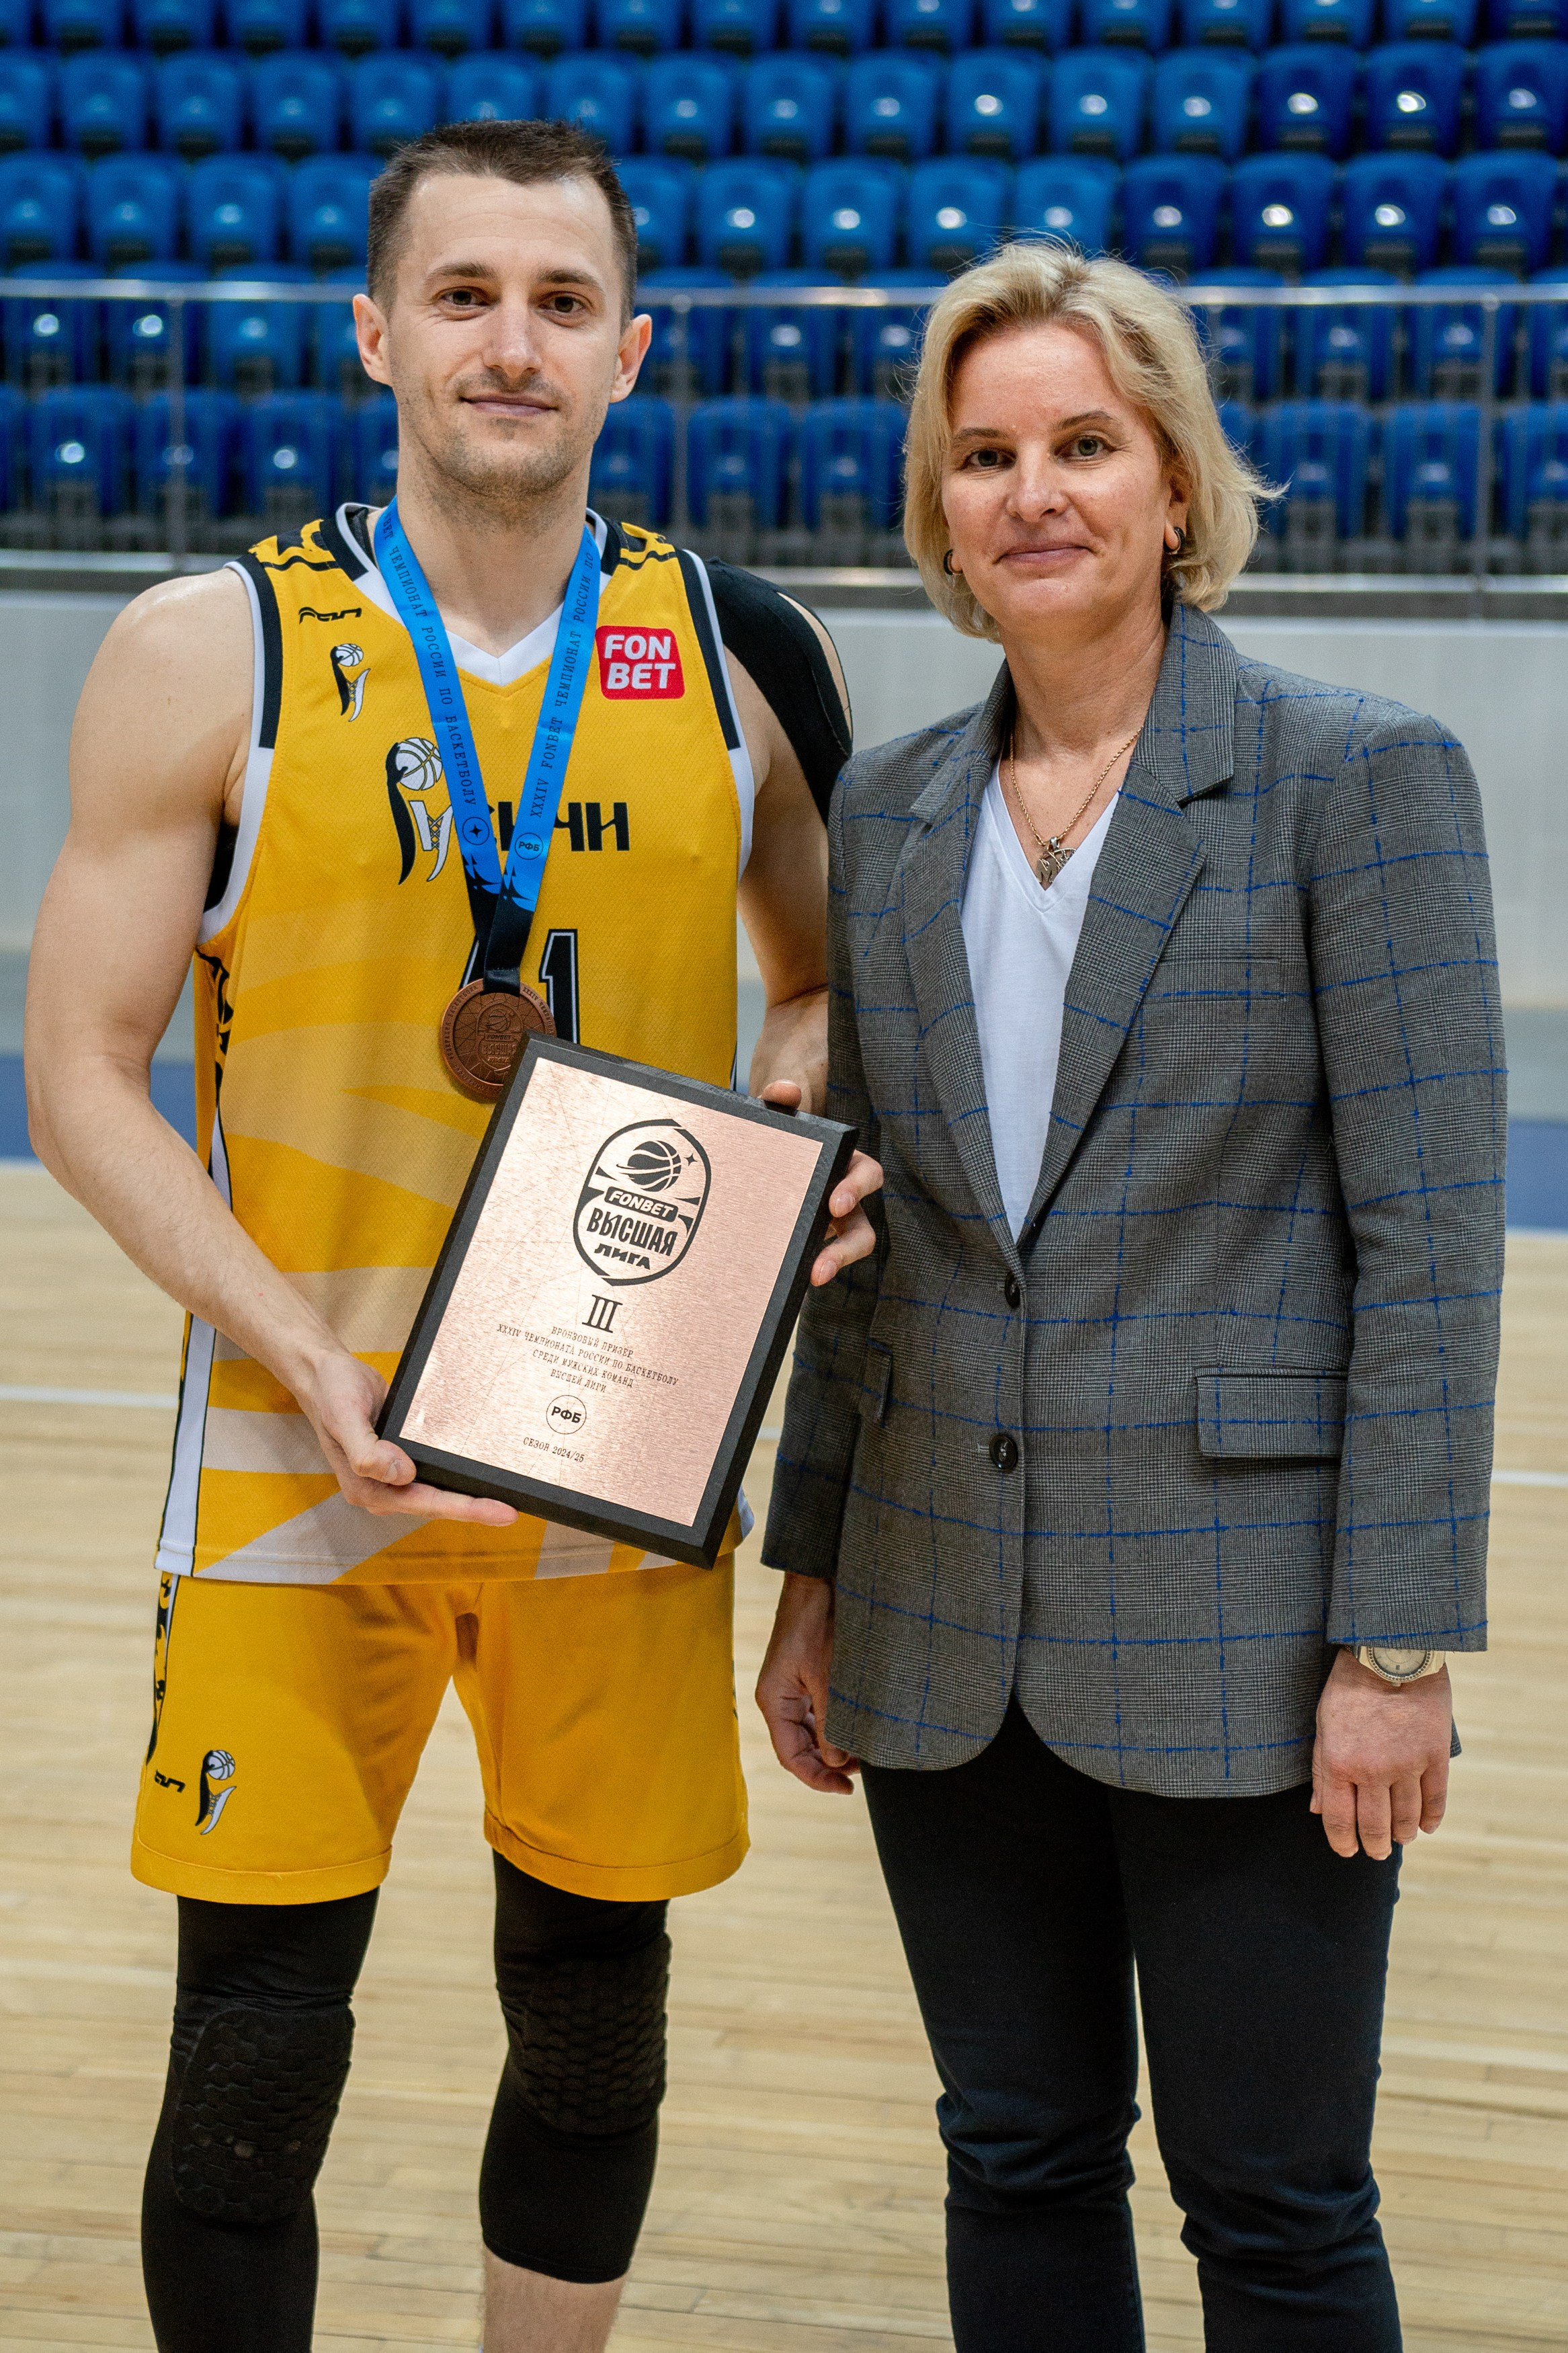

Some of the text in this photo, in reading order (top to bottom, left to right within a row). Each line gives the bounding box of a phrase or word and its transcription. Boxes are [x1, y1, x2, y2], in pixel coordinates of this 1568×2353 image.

[604, 635, 671, 660] FON
[389, 546, 428, 617] ЧЕМПИОНАТ
[421, 626, 447, 678] РОССИИ
[439, 688, 453, 705] ПО
[446, 715, 477, 805] БАСКЕТБОЛУ
[530, 777, 549, 818] XXXIV
[541, 717, 563, 769] FONBET
[555, 631, 581, 707] ЧЕМПИОНАТ
[573, 575, 591, 623] РОССИИ
[585, 553, 593, 569] ПО
[607, 662, 676, 690] BET
[518, 841, 540, 852] РФБ
[609, 1190, 674, 1218] FONBET
[586, 1207, 678, 1257] ВЫСШАЯ
[594, 1243, 651, 1270] ЛИГА
[581, 1294, 623, 1333] III
[551, 1326, 600, 1348] БРОНЗОВЫЙ
[524, 1332, 575, 1355] ЧЕМПИОНАТА
[578, 1349, 610, 1365] РОССИИ
[612, 1359, 623, 1369] ПО
[625, 1363, 679, 1386] БАСКЕТБОЛУ
[532, 1349, 634, 1388] СРЕДИ МУЖСКИХ КОМАНД
[550, 1369, 607, 1393] ВЫСШЕЙ ЛИГИ
[551, 1406, 582, 1423] РФБ
[523, 1437, 585, 1462] СЕЗОН 2024/25
